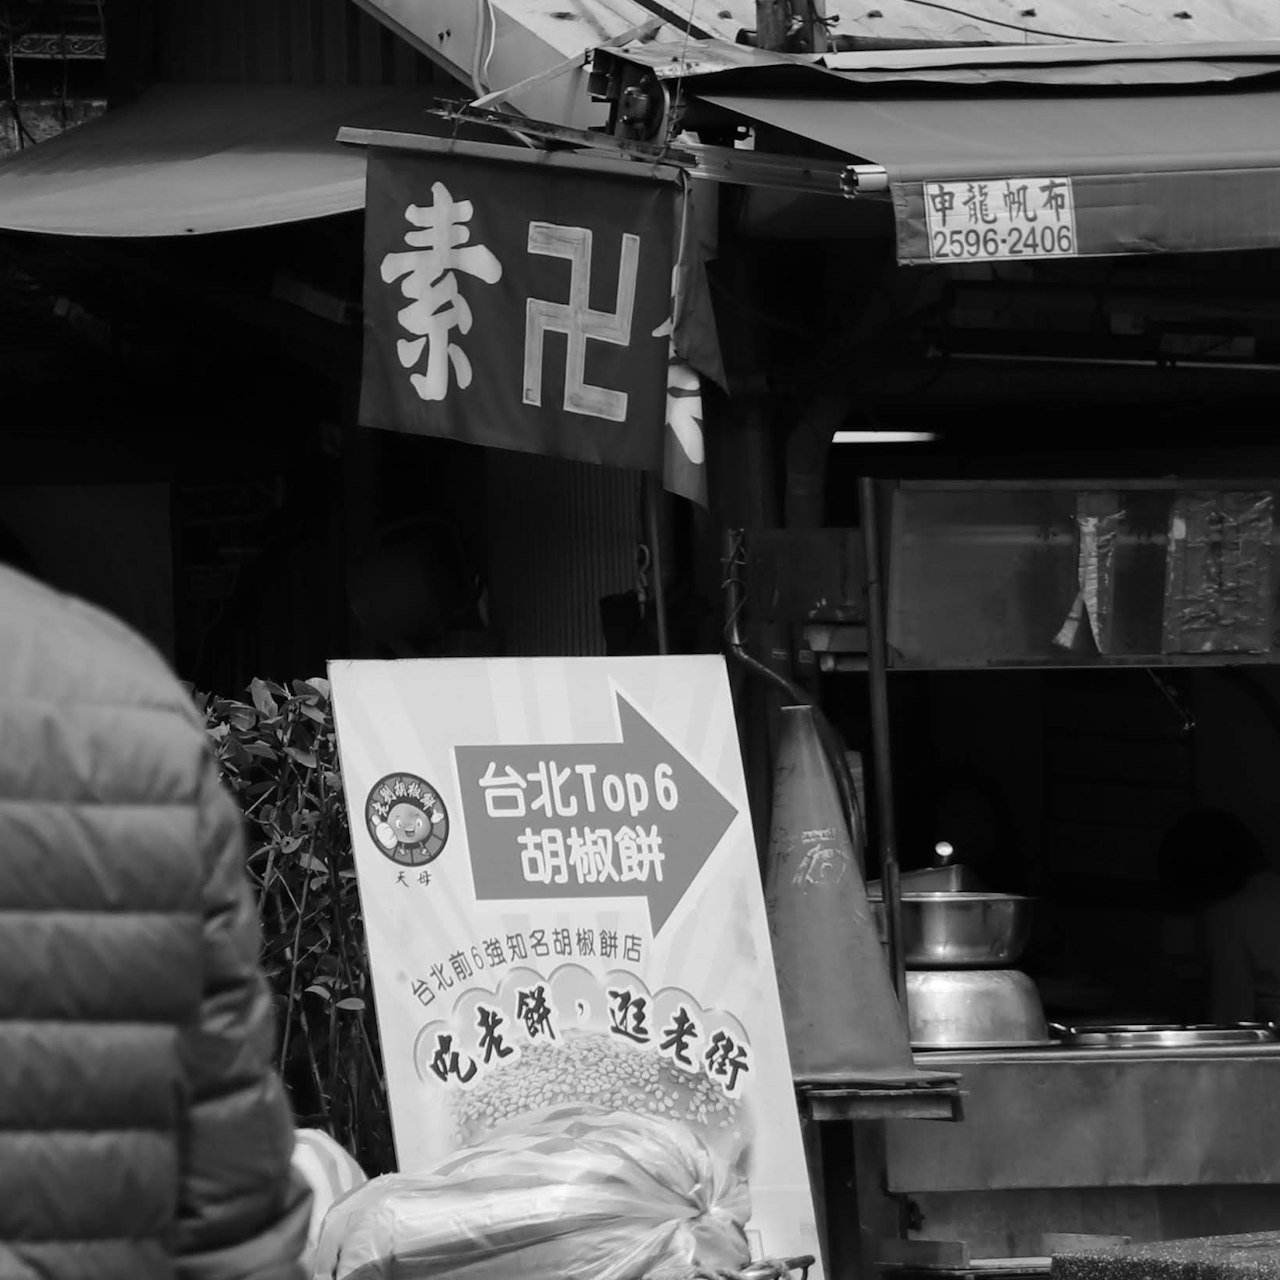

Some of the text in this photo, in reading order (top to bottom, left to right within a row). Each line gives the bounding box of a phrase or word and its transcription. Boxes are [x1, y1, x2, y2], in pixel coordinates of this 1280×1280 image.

[931, 180, 1067, 227] 申龍帆布
[394, 869, 433, 888] 天母
[516, 824, 666, 885] 胡椒餅
[410, 927, 644, 1007] 台北前6強知名胡椒餅店
